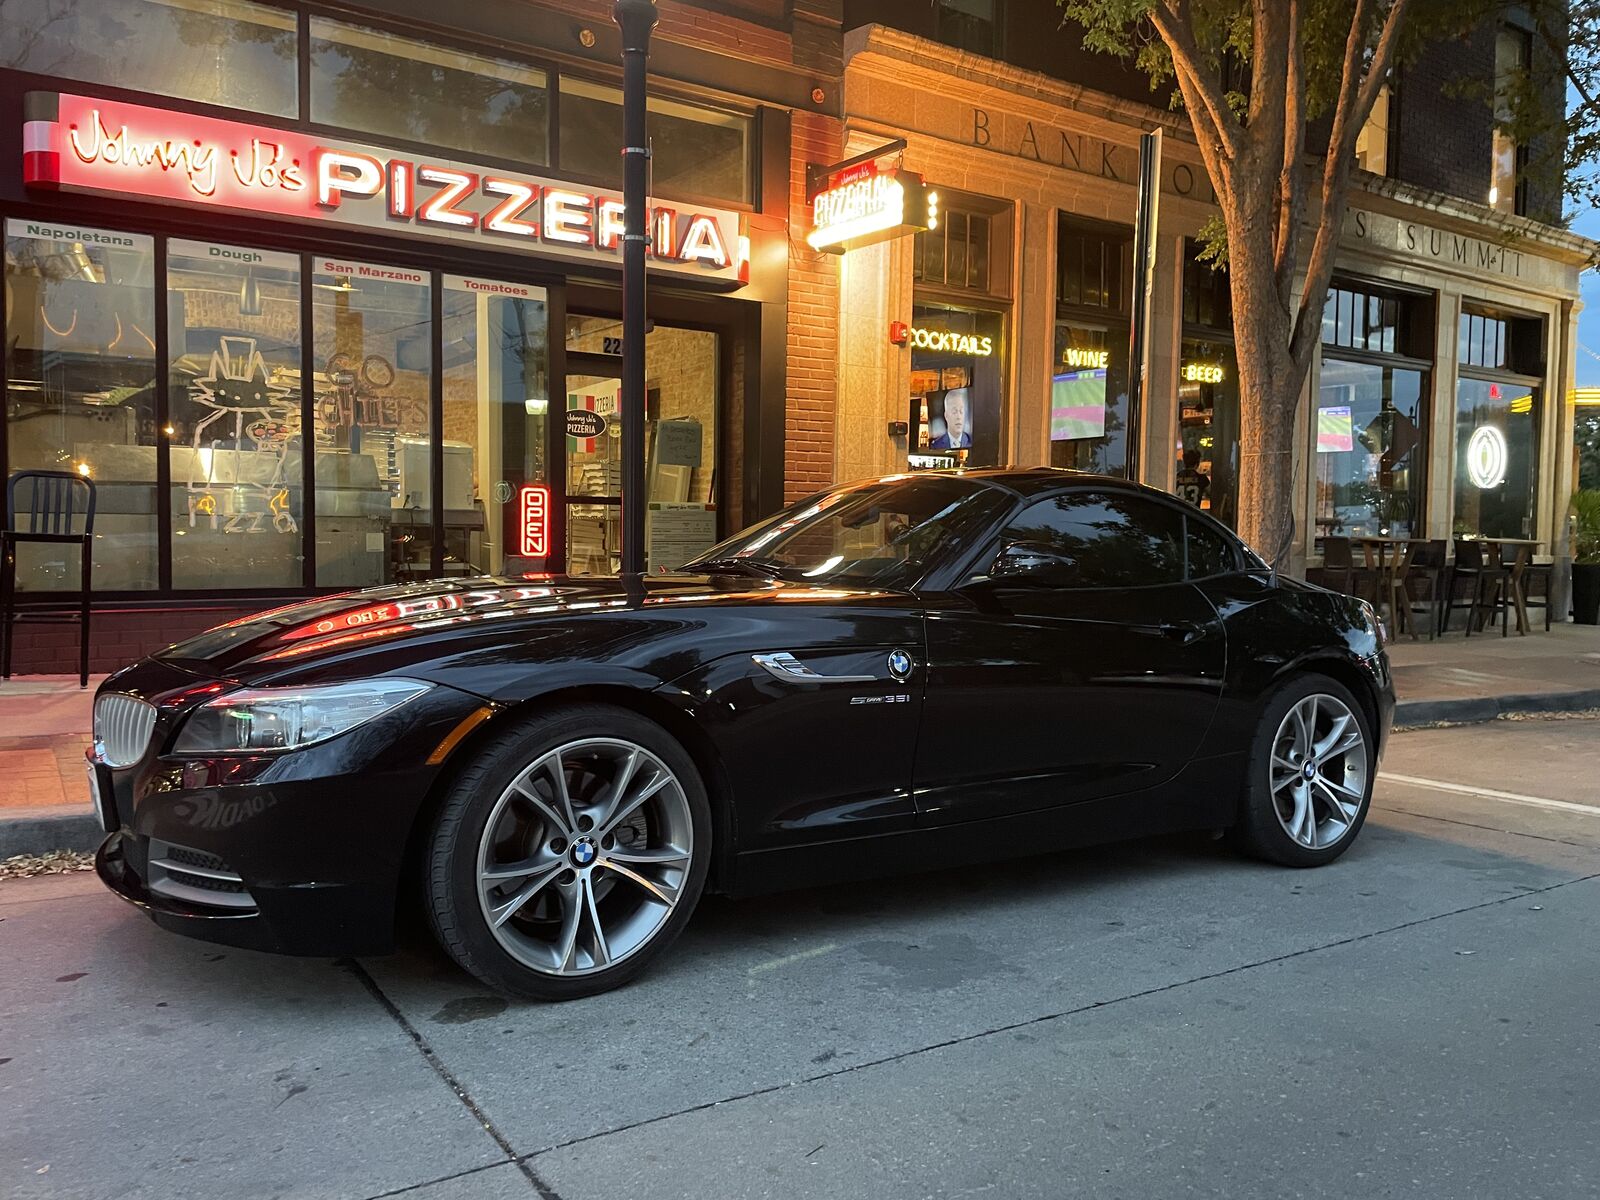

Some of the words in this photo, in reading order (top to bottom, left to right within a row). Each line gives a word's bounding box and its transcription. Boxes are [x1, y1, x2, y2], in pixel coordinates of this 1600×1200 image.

[70, 109, 217, 196] Johnny
[230, 138, 306, 192] Jo's
[314, 147, 732, 268] PIZZERIA
[972, 108, 1119, 180] BANK
[1406, 224, 1524, 277] SUMMIT
[26, 224, 134, 247] Napoletana
[208, 246, 262, 263] Dough
[324, 261, 358, 277] San
[362, 265, 421, 284] Marzano
[463, 279, 529, 297] Tomatoes
[909, 327, 992, 357] COCKTAILS
[1066, 347, 1109, 369] WINE
[1186, 364, 1223, 383] BEER
[566, 413, 585, 425] Johnny
[567, 423, 596, 434] PIZZERIA
[526, 492, 543, 552] OPEN
